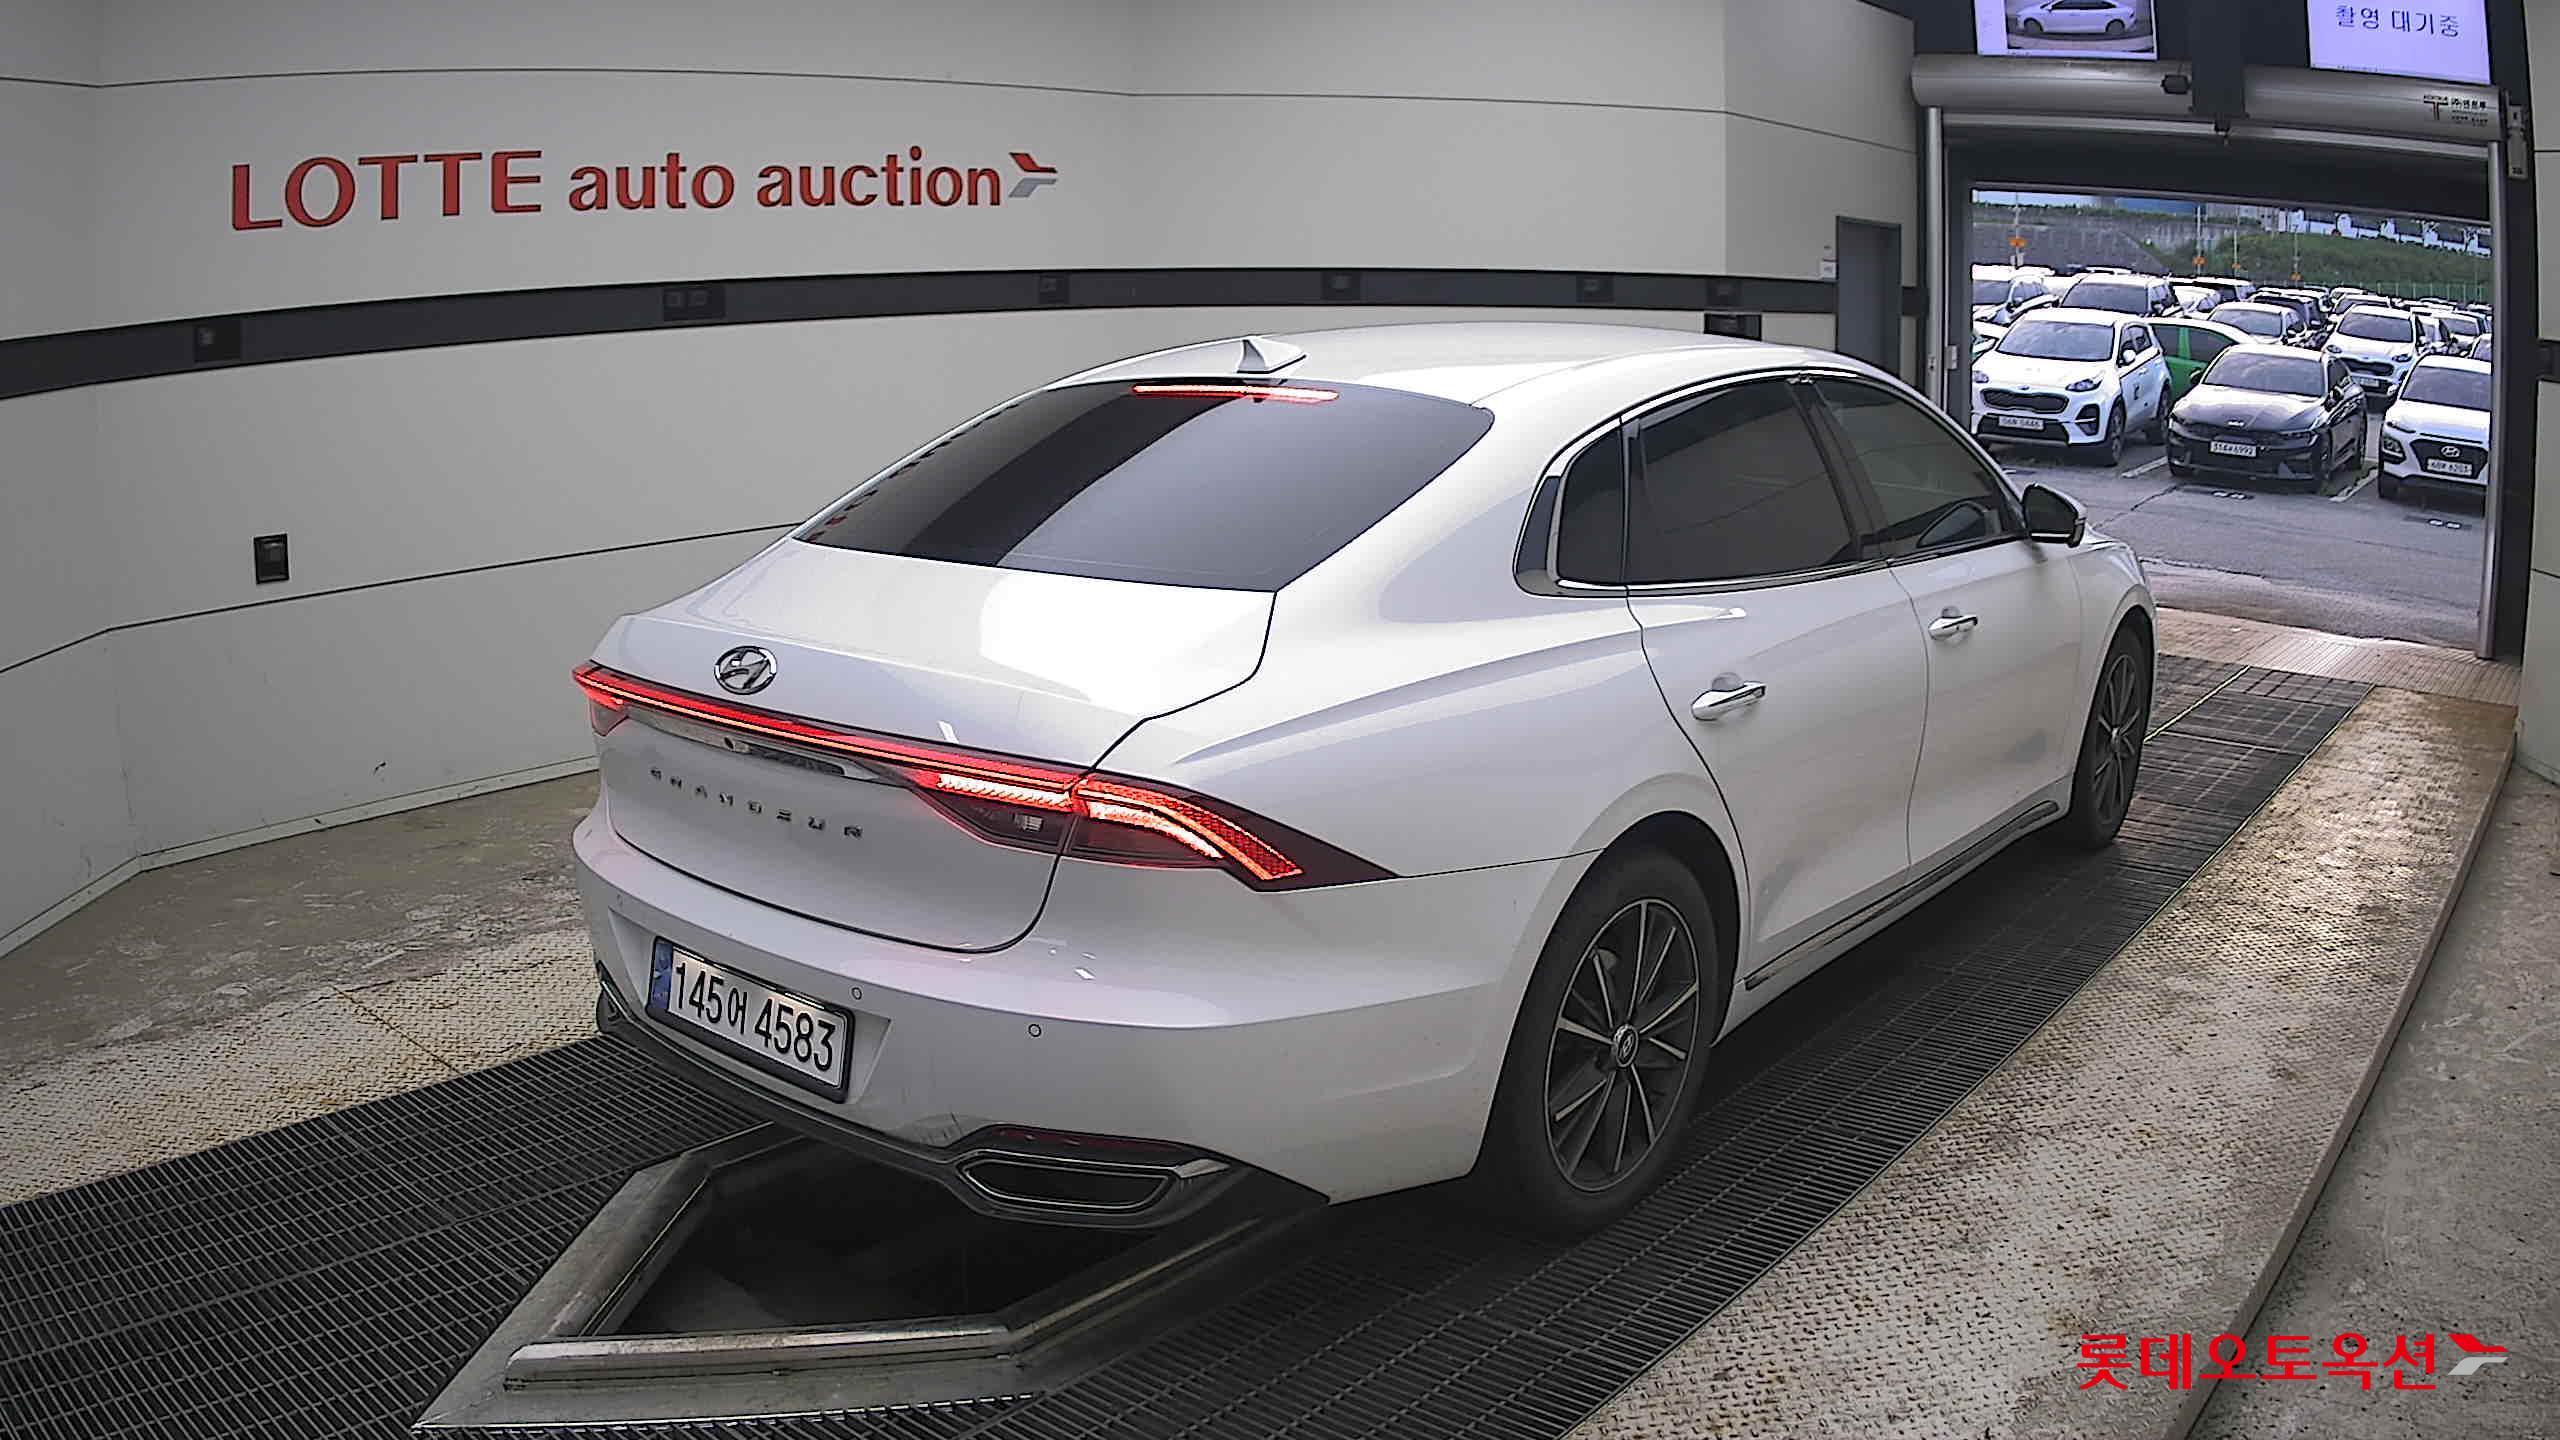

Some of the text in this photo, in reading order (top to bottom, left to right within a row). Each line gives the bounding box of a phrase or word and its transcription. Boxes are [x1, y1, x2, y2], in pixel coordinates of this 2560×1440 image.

[2336, 4, 2460, 38] 촬영 대기중
[231, 145, 1003, 231] LOTTE auto auction
[675, 962, 837, 1072] 145어 4583
